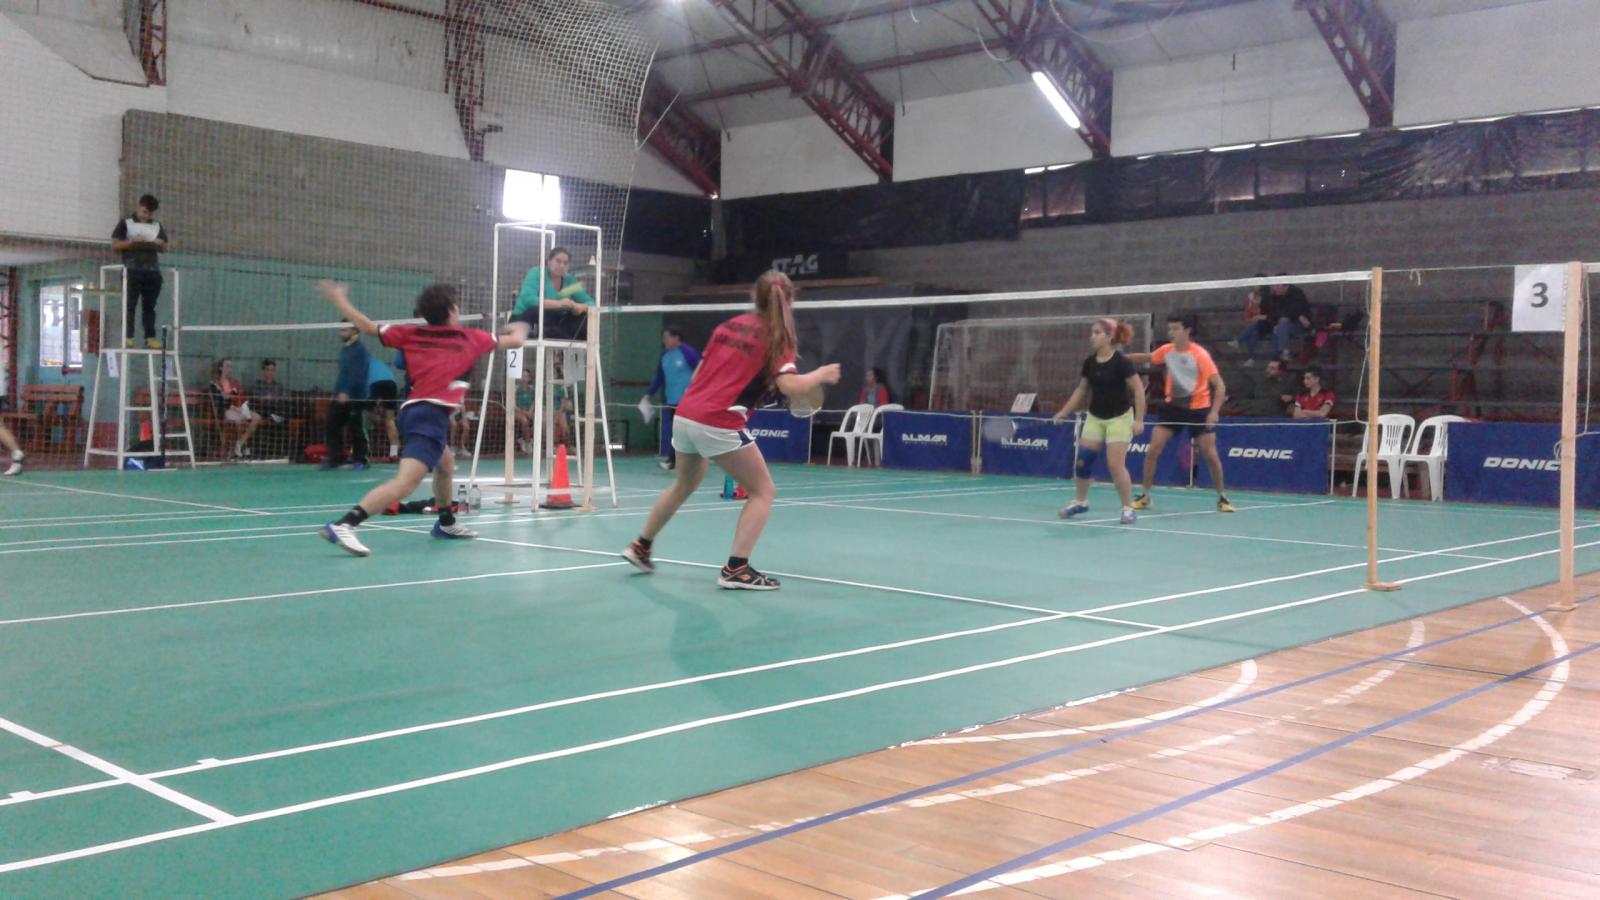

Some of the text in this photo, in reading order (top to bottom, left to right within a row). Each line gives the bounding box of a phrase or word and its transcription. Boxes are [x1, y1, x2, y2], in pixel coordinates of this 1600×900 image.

[1531, 282, 1549, 308] 3
[509, 350, 517, 368] 2
[902, 433, 947, 443] ALMAR
[1001, 437, 1048, 447] ALMAR
[1228, 447, 1293, 460] DONIC
[1483, 457, 1561, 471] DONIC
